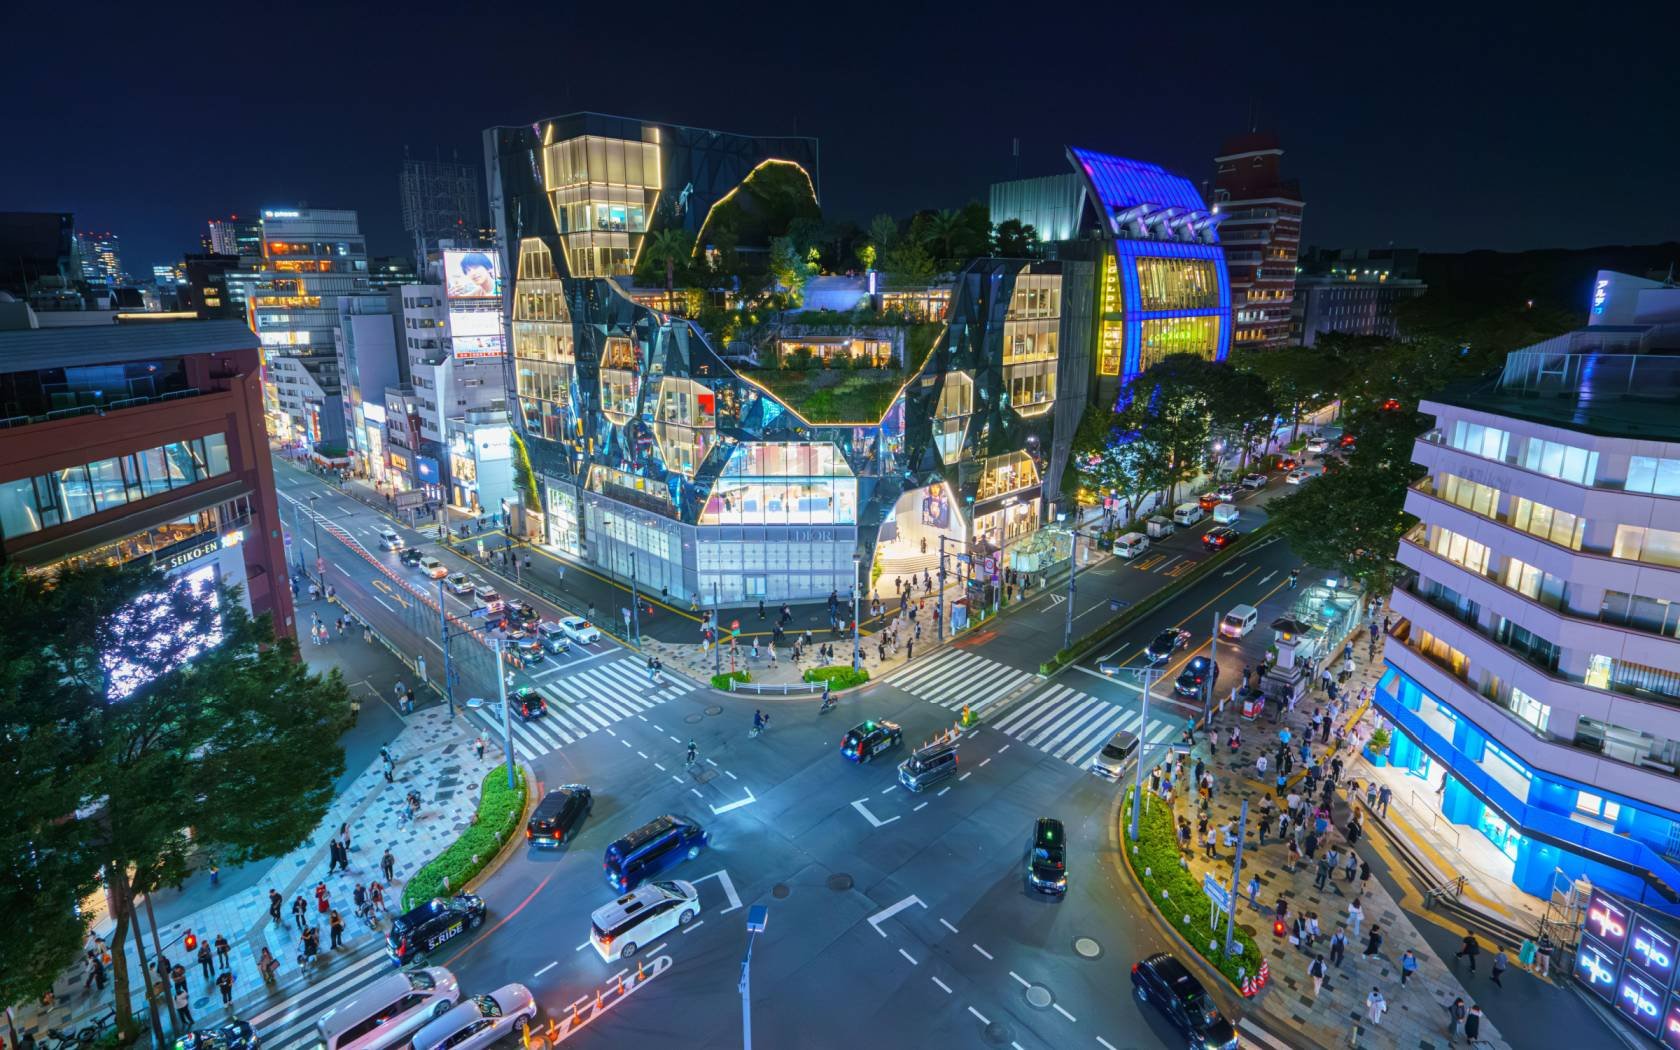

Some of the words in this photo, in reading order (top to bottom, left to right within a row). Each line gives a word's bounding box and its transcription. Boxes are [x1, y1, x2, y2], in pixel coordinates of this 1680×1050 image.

[795, 530, 832, 541] DIOR
[171, 541, 218, 568] SEIKO-EN
[428, 924, 464, 951] S.RIDE
